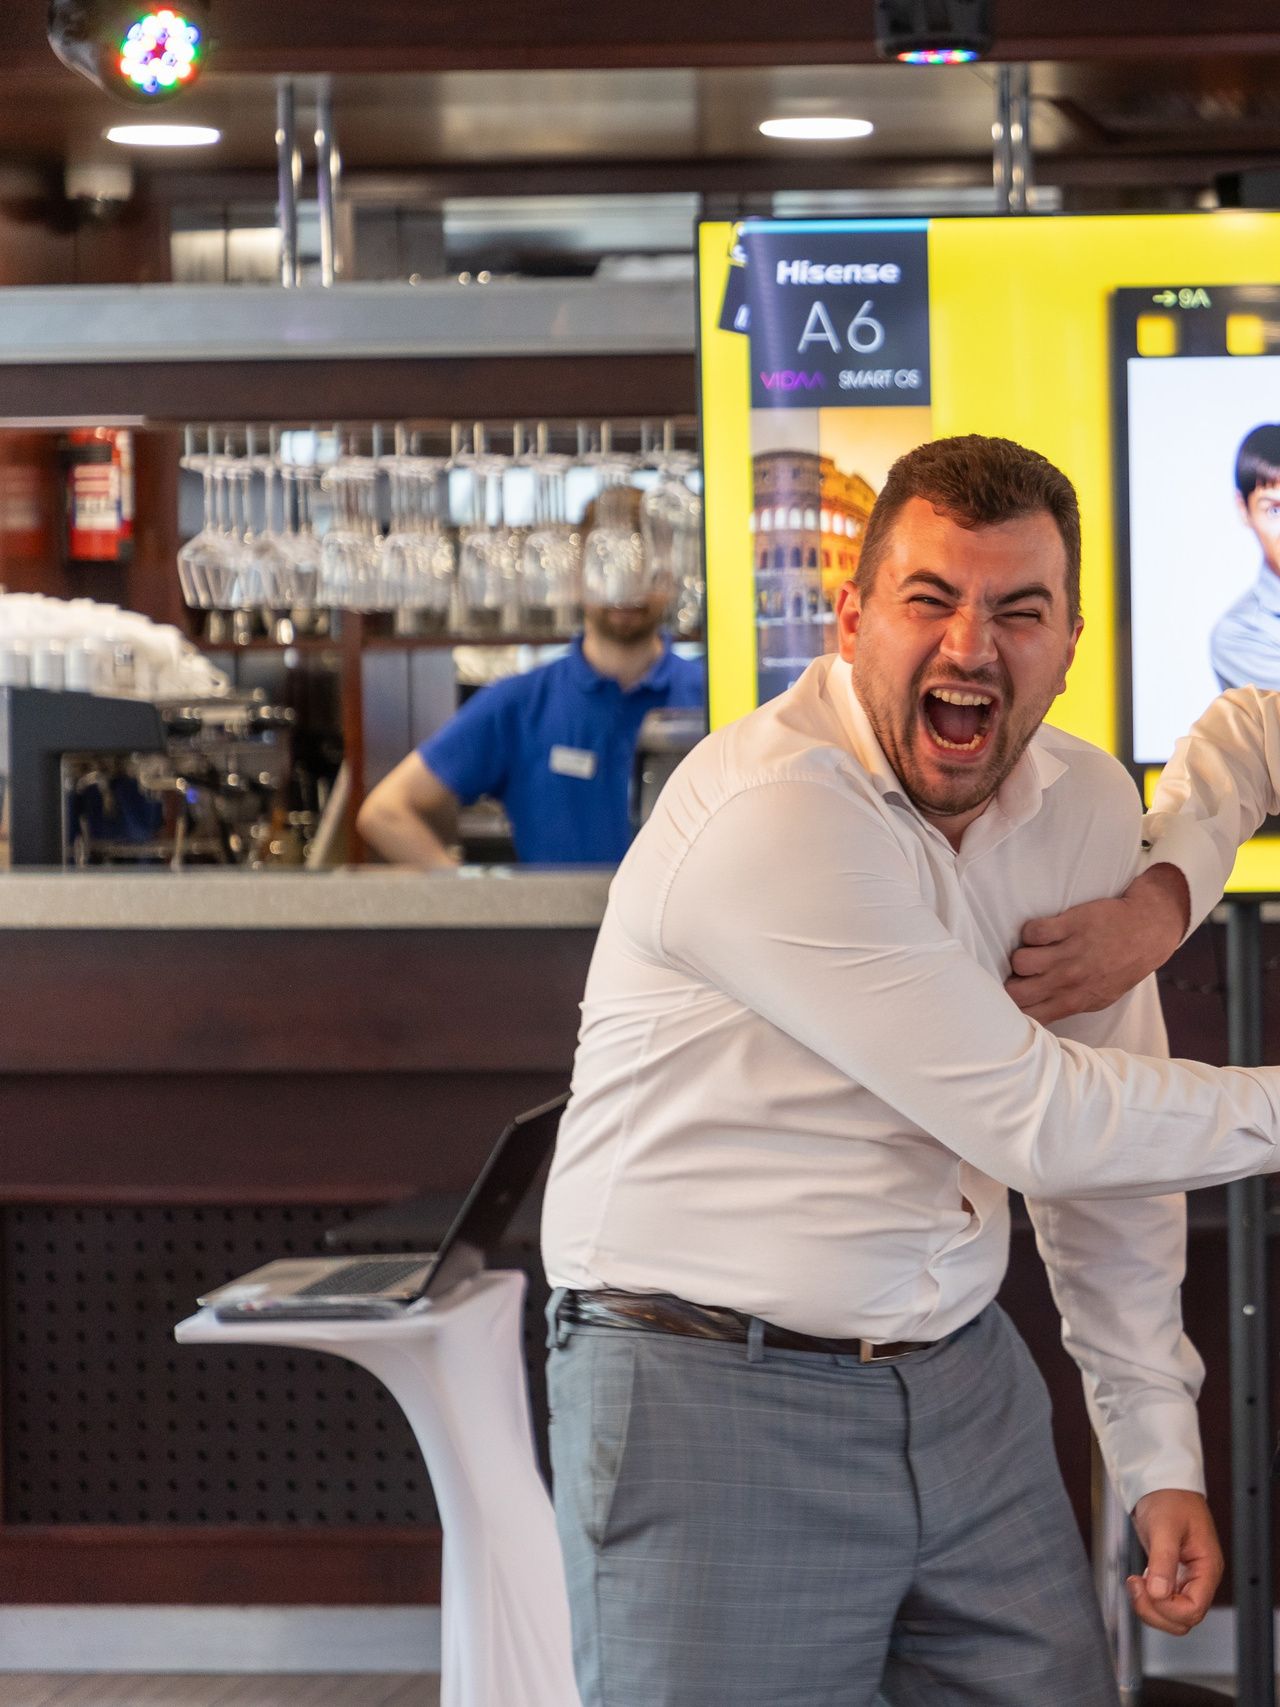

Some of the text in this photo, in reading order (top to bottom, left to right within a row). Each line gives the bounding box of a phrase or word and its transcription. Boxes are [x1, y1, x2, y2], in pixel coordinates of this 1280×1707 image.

[776, 259, 902, 285] Hisense
[1178, 288, 1212, 309] 9A
[797, 299, 886, 354] A6
[838, 369, 894, 391] SMART
[894, 368, 922, 390] OS
